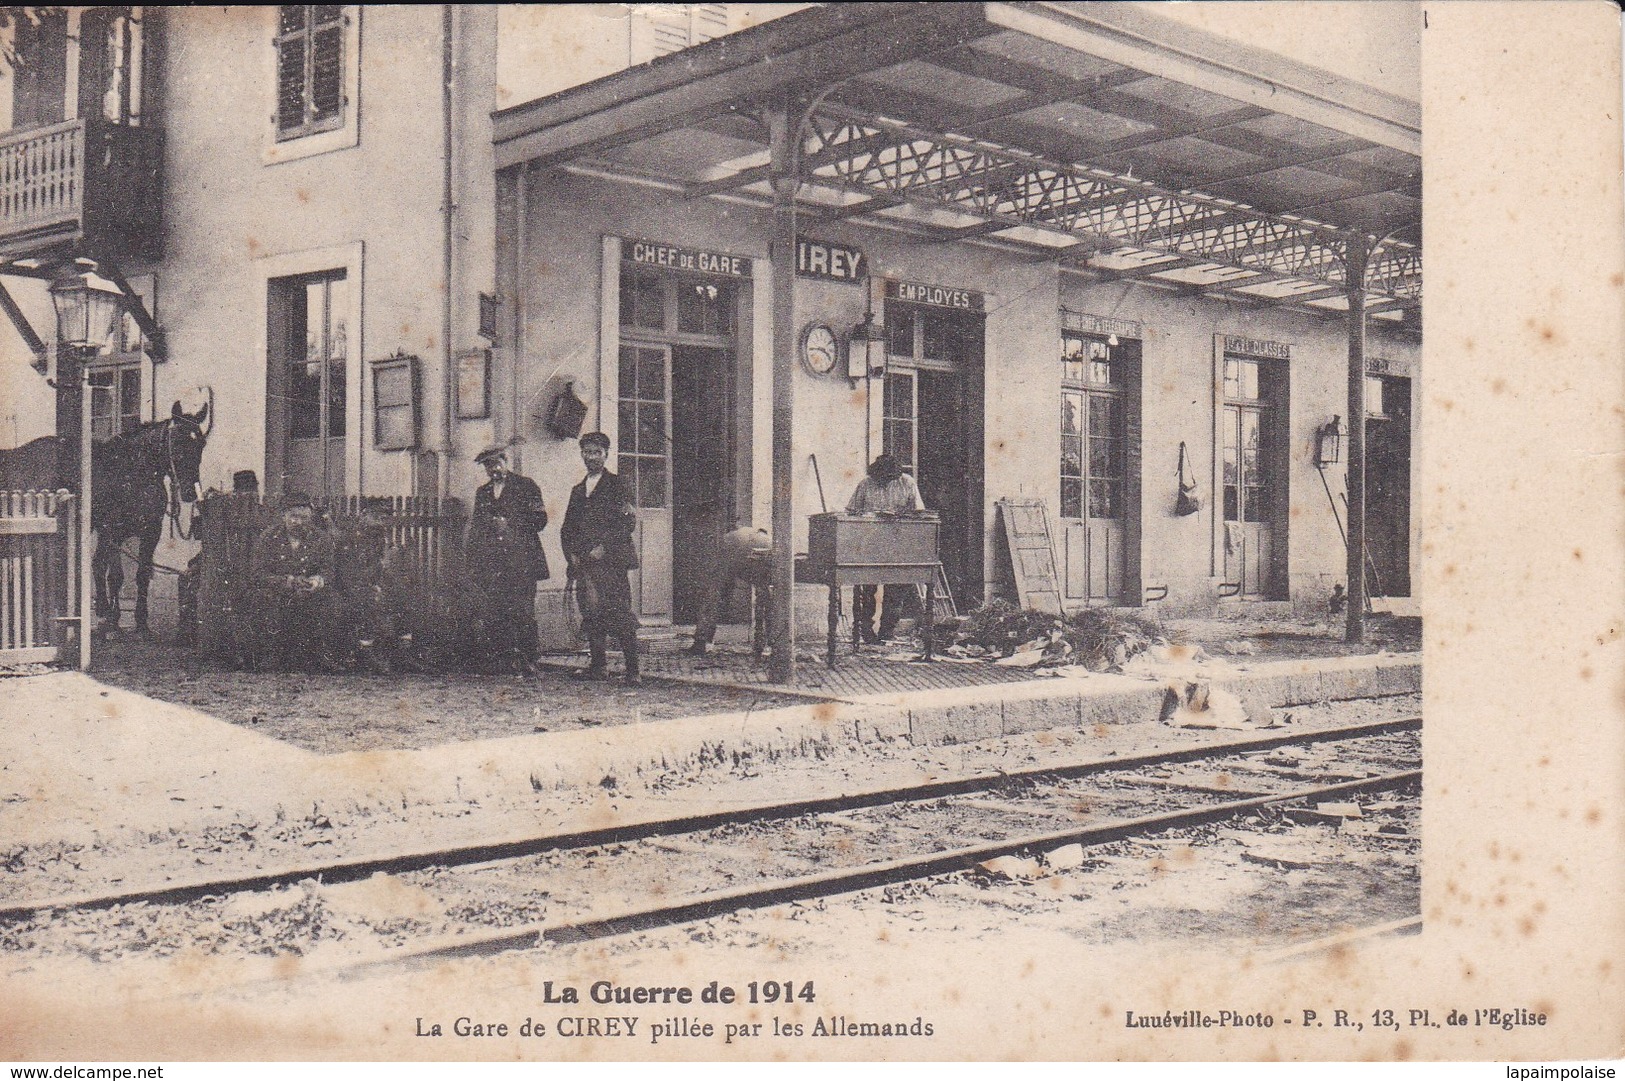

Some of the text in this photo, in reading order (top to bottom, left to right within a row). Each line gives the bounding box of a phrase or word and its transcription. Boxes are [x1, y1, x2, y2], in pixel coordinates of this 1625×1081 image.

[634, 243, 742, 275] CHEF DE GARE
[799, 242, 862, 279] IREY
[899, 283, 970, 308] EMPLOYES
